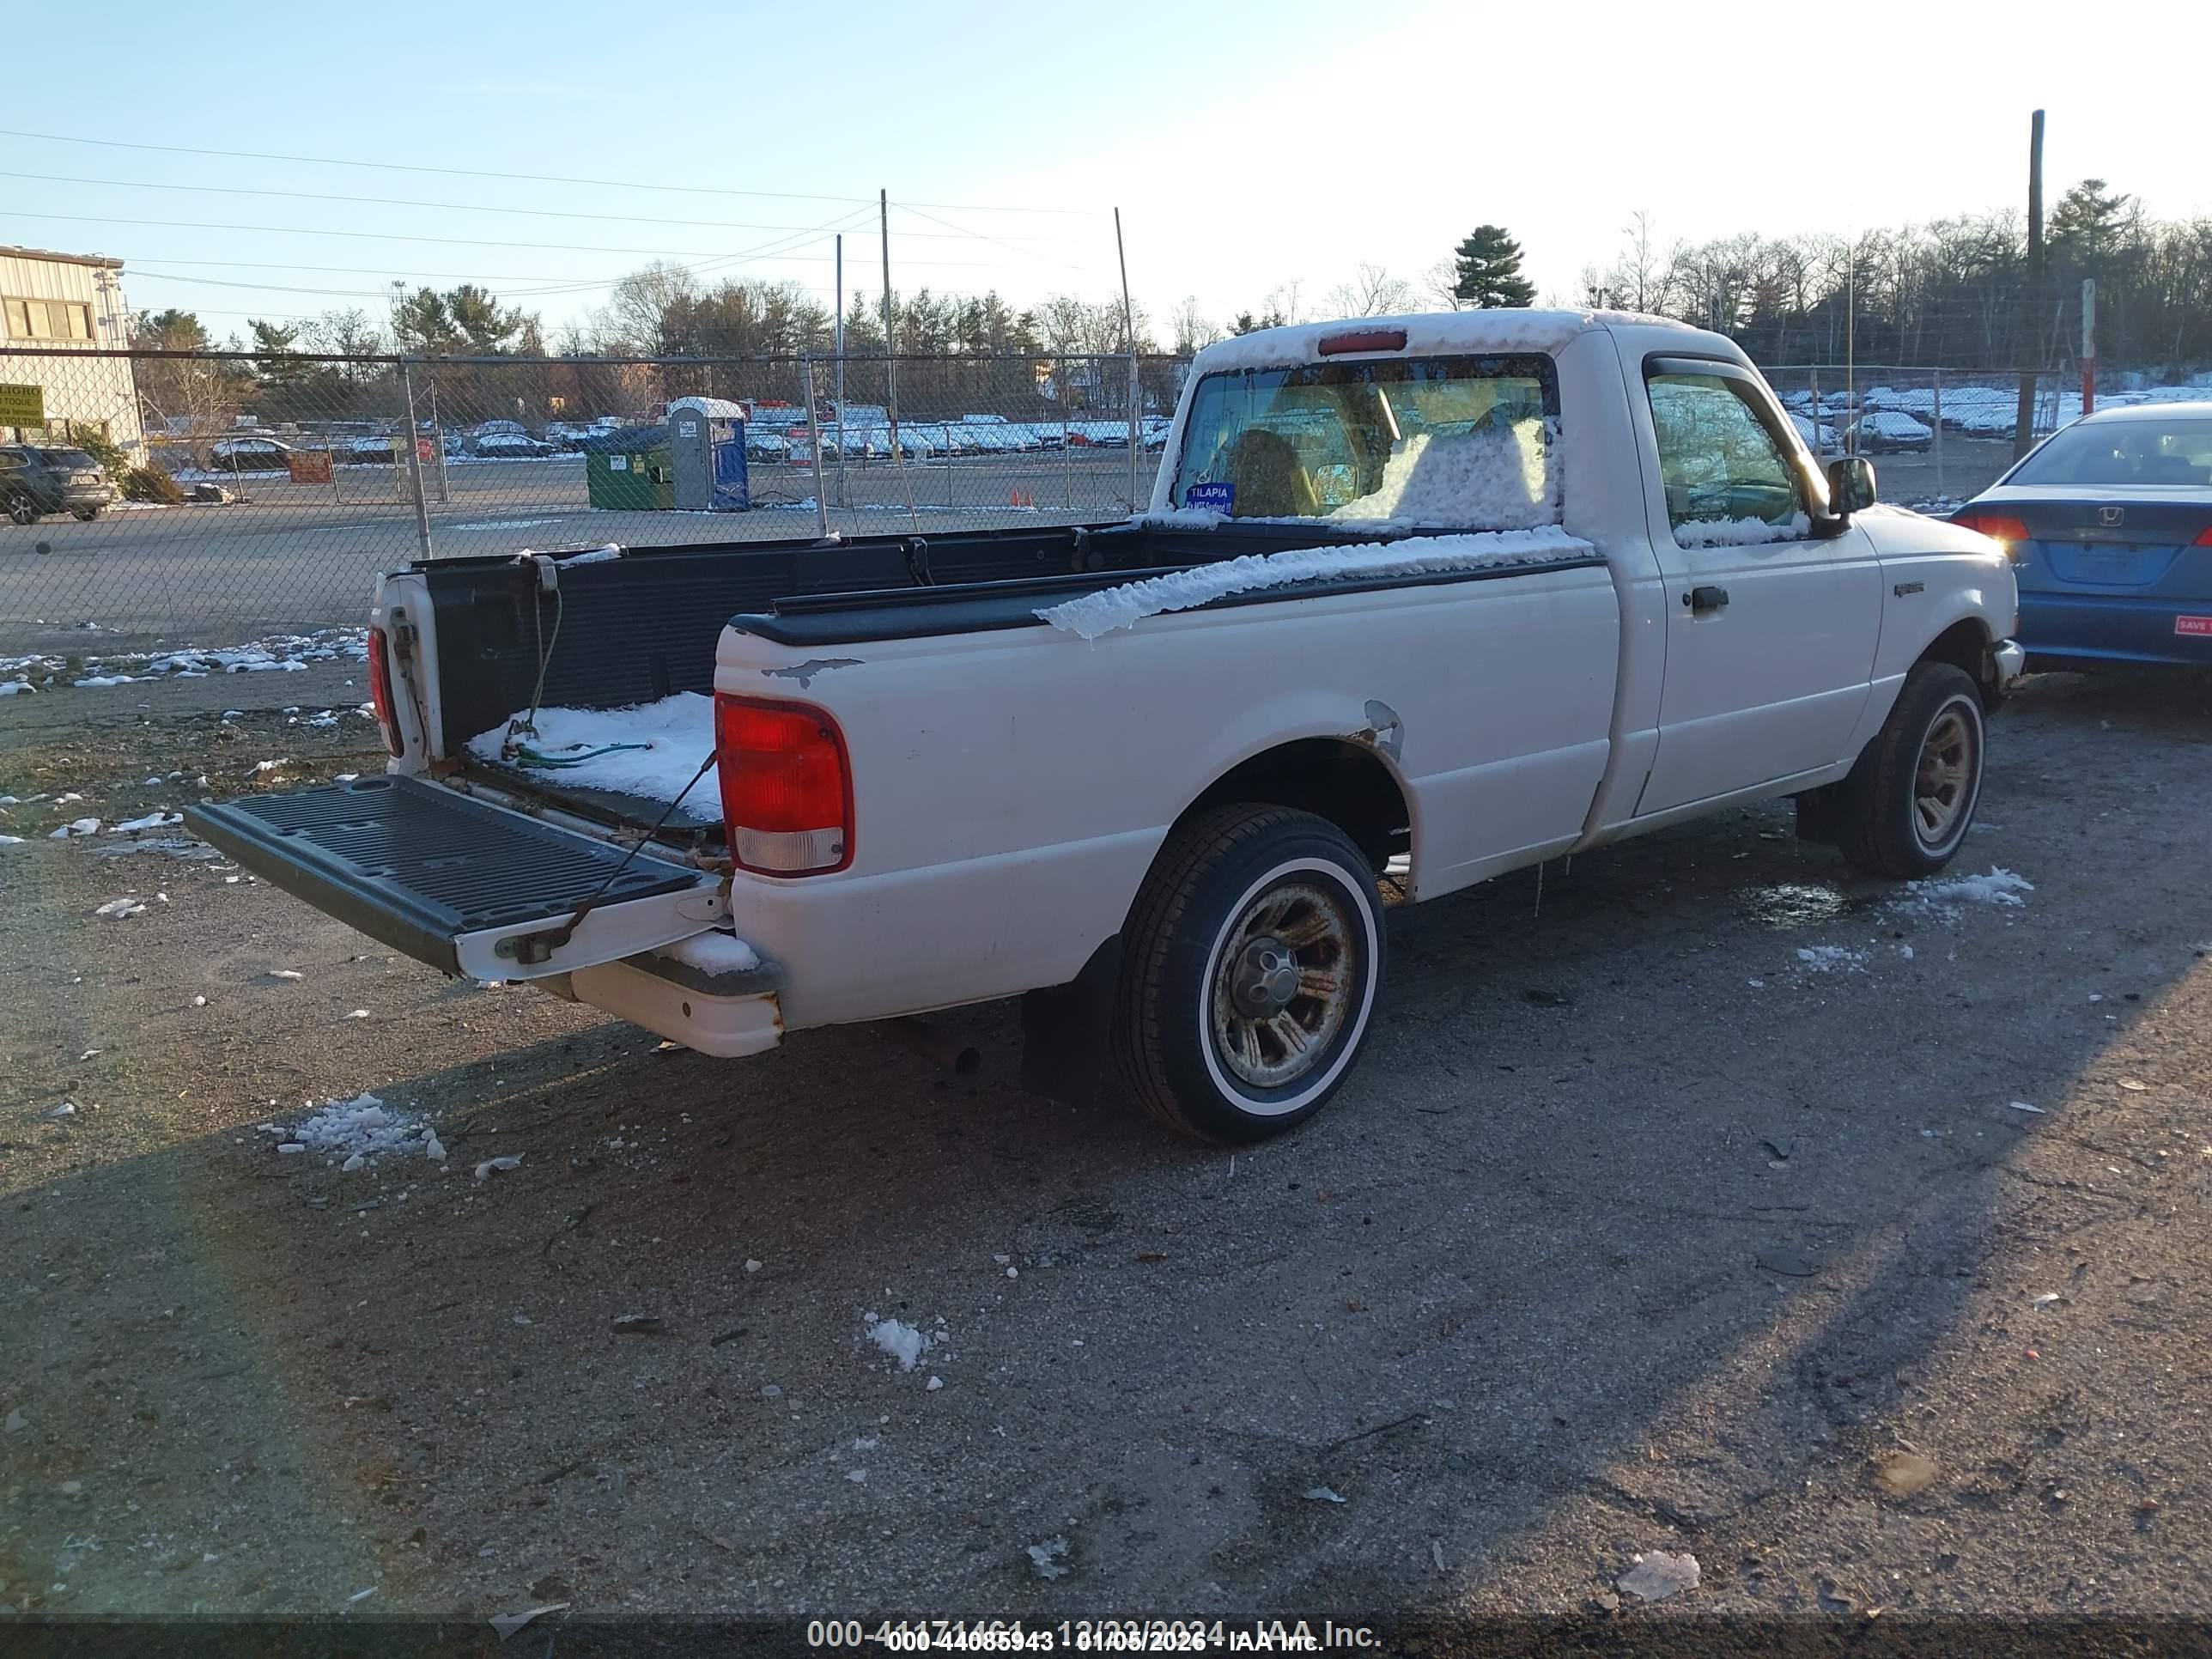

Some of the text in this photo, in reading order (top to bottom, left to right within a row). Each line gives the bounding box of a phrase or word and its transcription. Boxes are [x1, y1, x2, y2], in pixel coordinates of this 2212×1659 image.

[1190, 487, 1228, 498] TILAPIA
[1206, 501, 1225, 513] Seafood
[2179, 621, 2206, 631] SAVE
